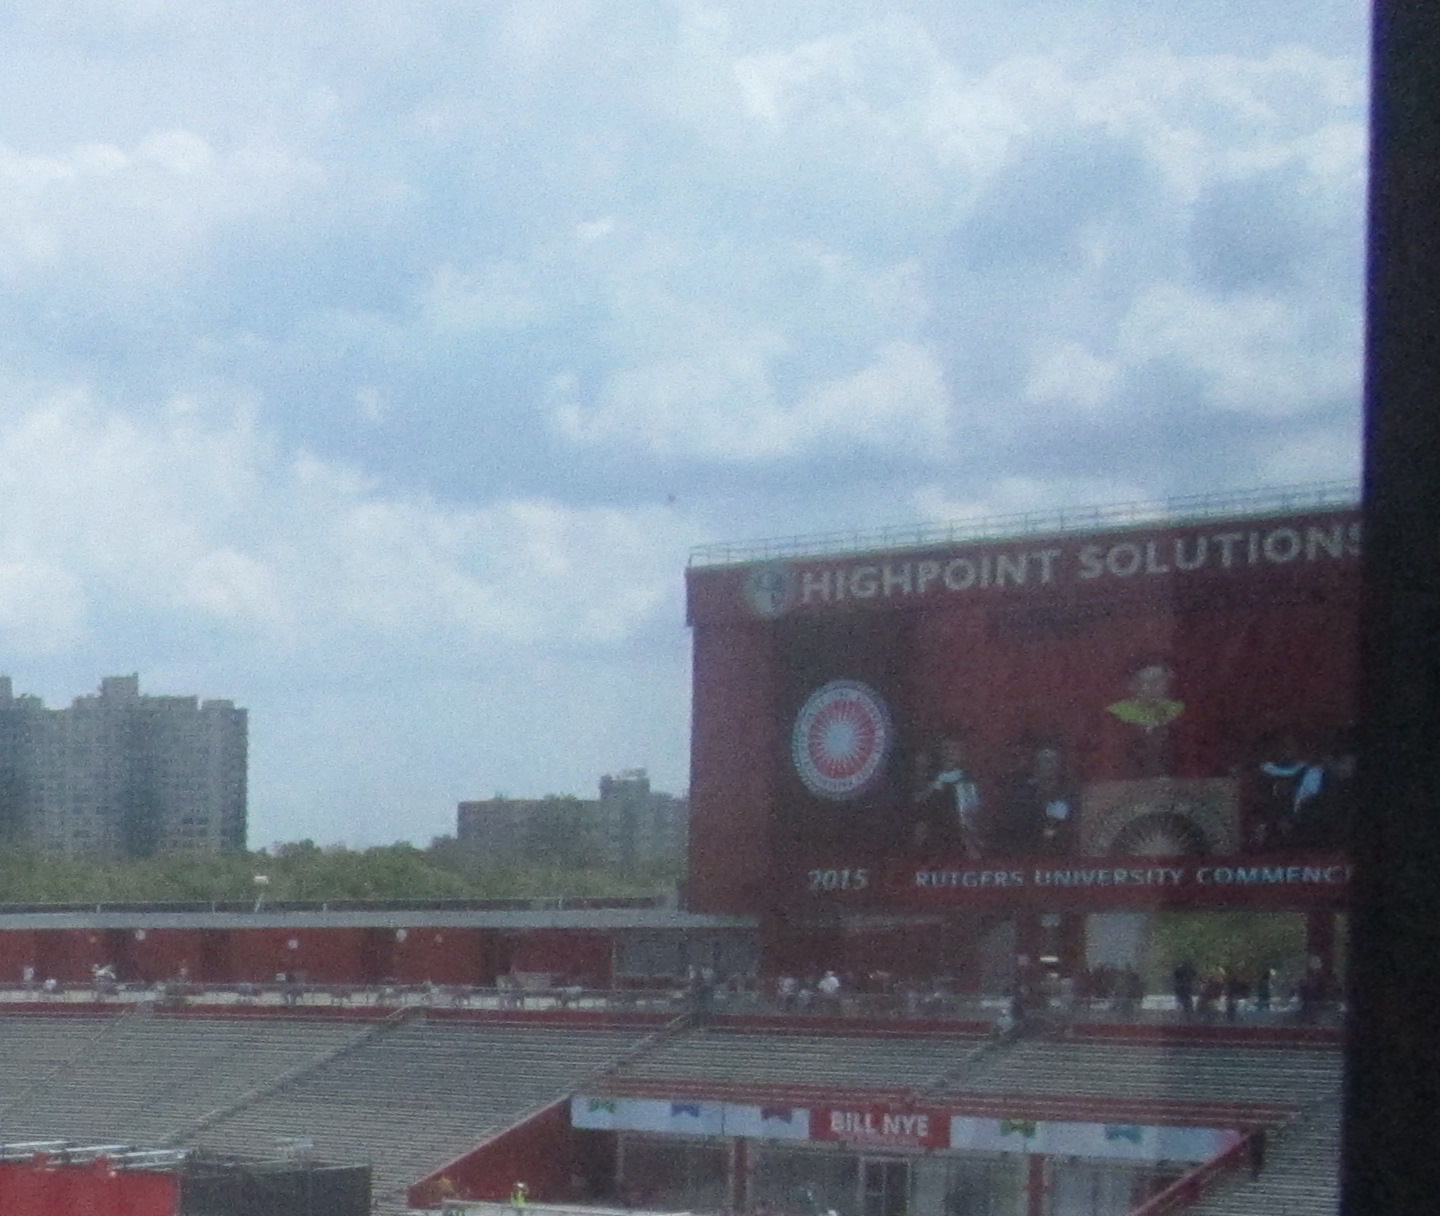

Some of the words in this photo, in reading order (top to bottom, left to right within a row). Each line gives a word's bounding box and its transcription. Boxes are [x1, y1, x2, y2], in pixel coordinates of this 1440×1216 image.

[802, 547, 1061, 603] HIGHPOINT
[810, 869, 868, 891] 2015
[914, 872, 1022, 888] RUTGERS
[1034, 867, 1185, 886] UNIVERSITY
[1196, 866, 1351, 884] COMMENC
[830, 1110, 877, 1133] BILL
[884, 1112, 928, 1137] NYE
